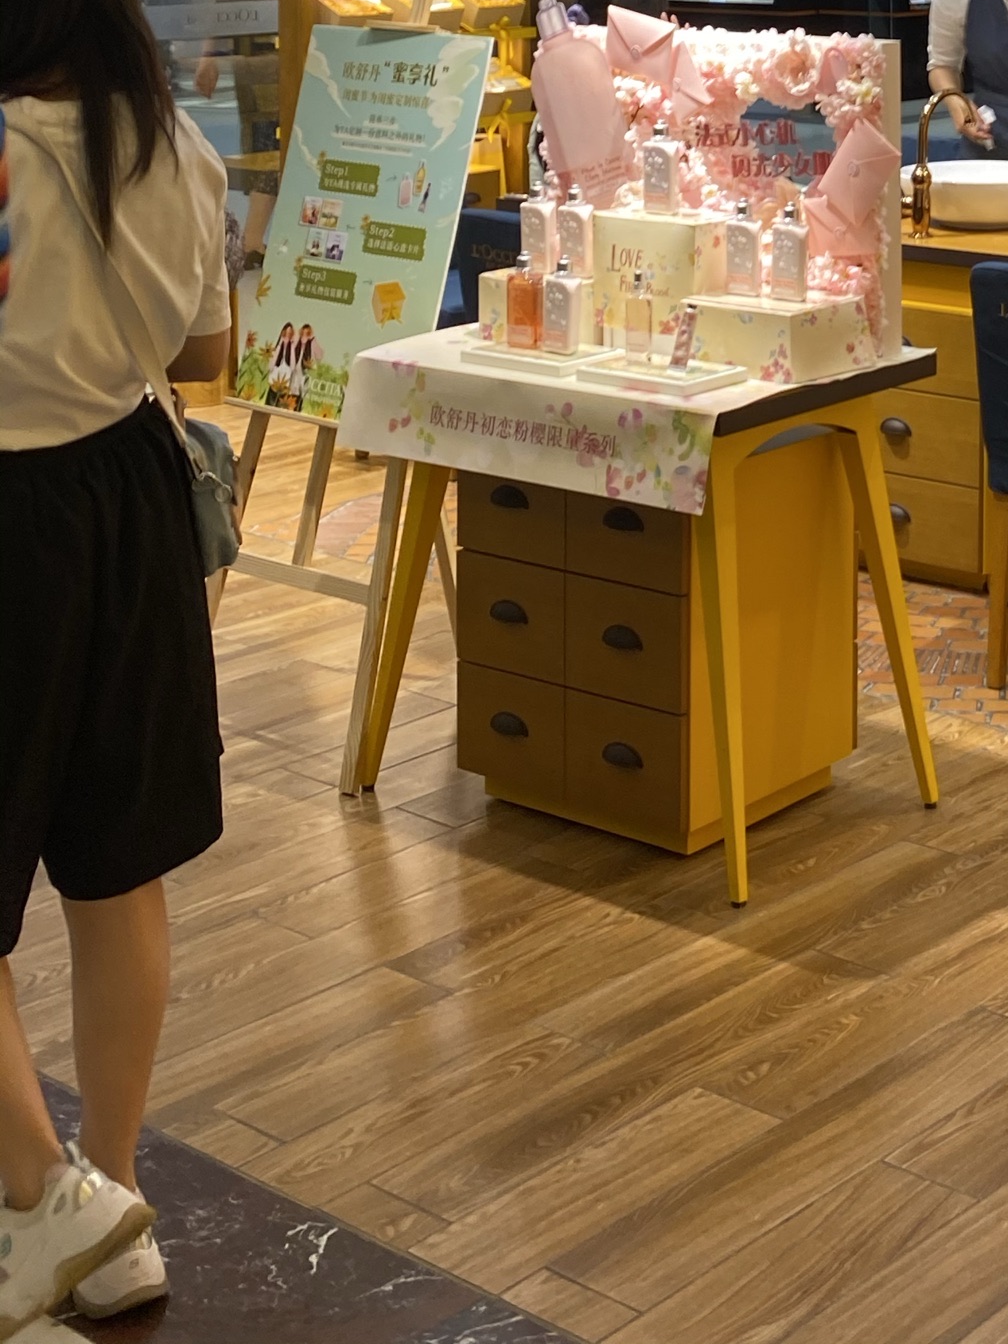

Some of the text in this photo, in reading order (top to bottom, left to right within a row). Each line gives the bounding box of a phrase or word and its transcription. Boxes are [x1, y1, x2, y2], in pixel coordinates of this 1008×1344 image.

[324, 163, 349, 177] Step1
[369, 224, 396, 239] Step2
[611, 244, 643, 272] LOVE
[302, 267, 328, 283] Step3
[429, 404, 617, 457] 欧舒丹初恋粉樱限量系列
